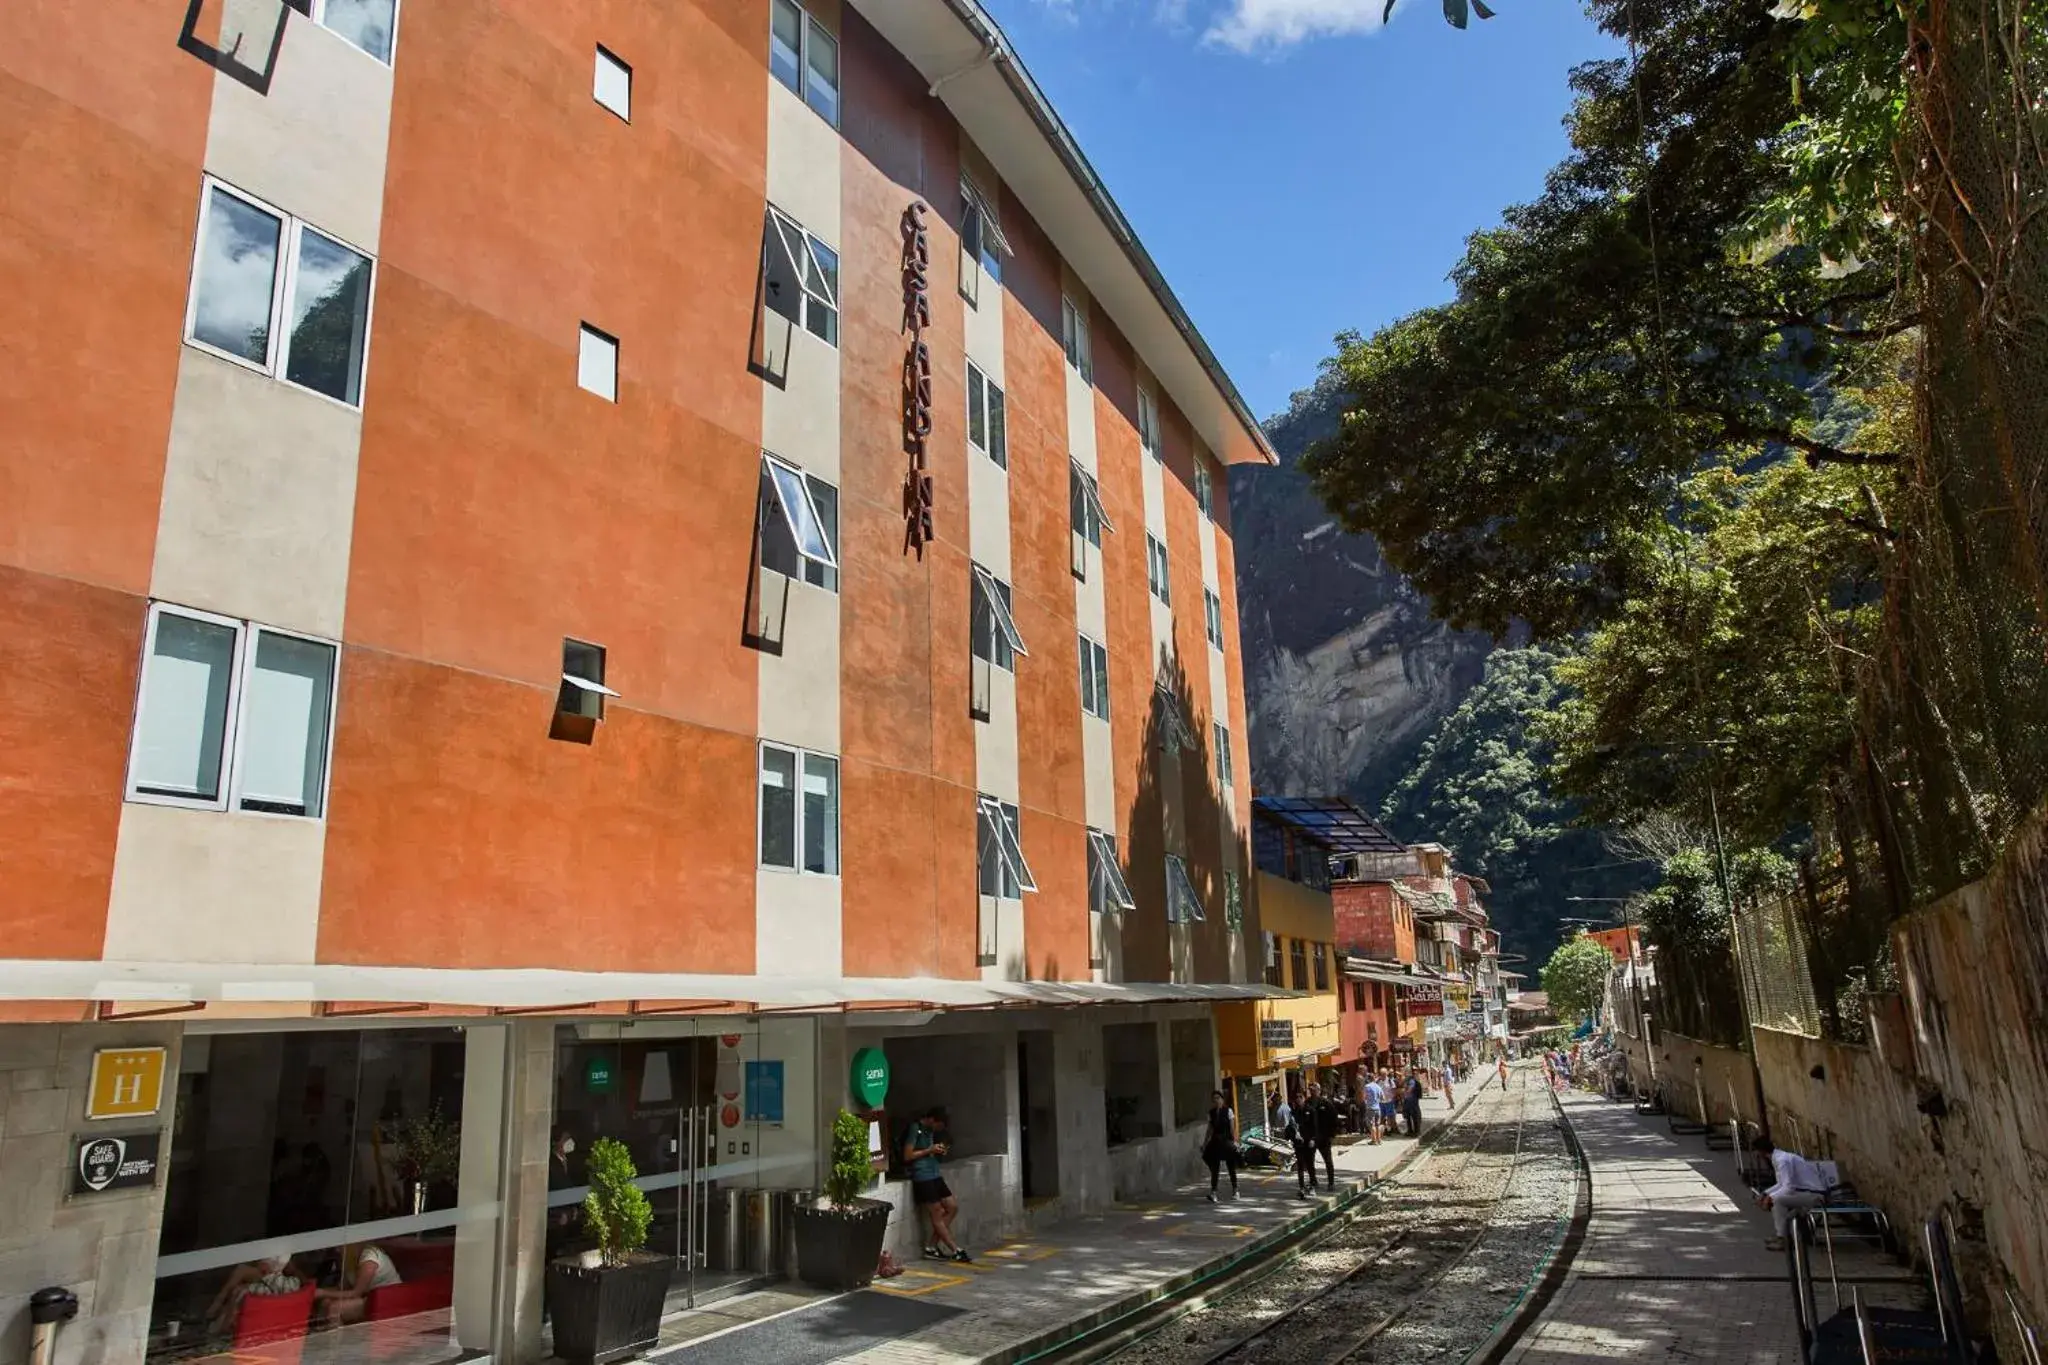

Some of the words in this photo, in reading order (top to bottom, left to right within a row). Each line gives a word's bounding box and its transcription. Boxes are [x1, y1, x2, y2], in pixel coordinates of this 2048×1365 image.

[908, 201, 931, 328] CASA
[914, 341, 935, 542] ANDINA
[110, 1073, 142, 1105] H
[89, 1152, 115, 1165] GUARD
[94, 1145, 114, 1155] SAFE
